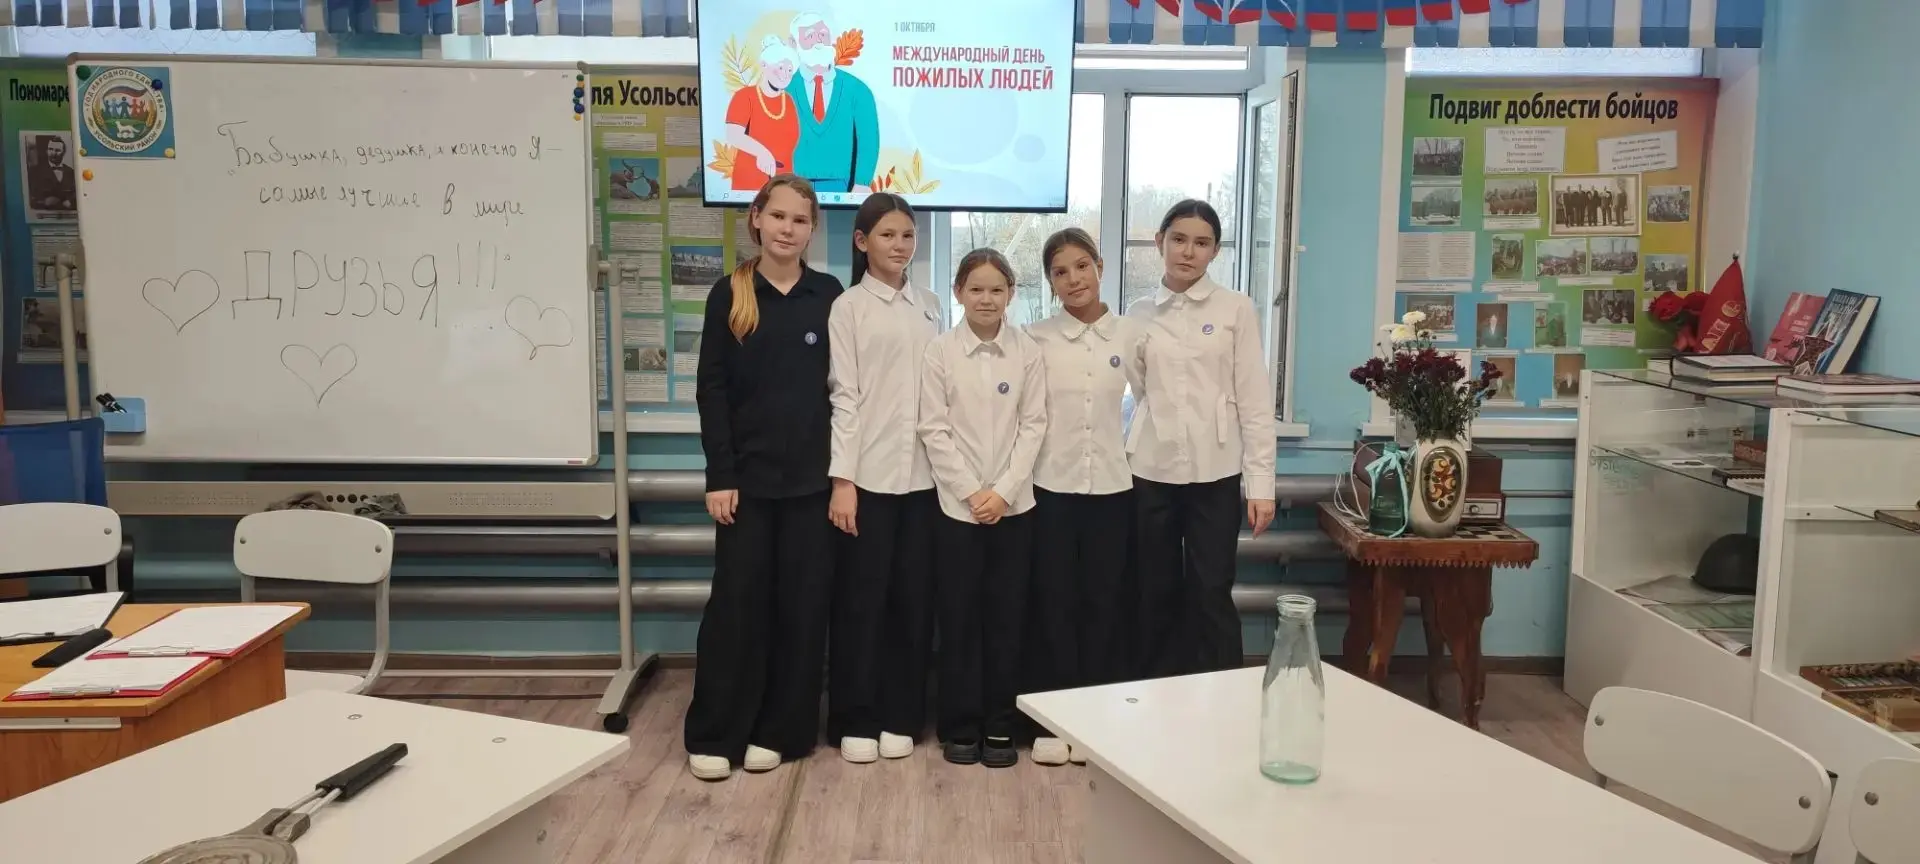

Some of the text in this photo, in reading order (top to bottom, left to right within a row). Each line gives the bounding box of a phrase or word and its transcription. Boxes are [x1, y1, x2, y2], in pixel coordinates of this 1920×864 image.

[893, 22, 936, 33] 1 ОКТЯБРЯ
[892, 45, 1046, 65] МЕЖДУНАРОДНЫЙ ДЕНЬ
[92, 69, 134, 91] НАРОДНОГО
[135, 73, 165, 110] ЕДИТВА
[892, 65, 1054, 92] ПОЖИЛЫХ ЛЮДЕЙ
[1429, 91, 1679, 125] Подвиг доблести бойцов
[94, 130, 158, 151] УСОЛЬСКИЙ РАЙОН
[450, 141, 517, 158] конечно
[473, 198, 526, 227] мире
